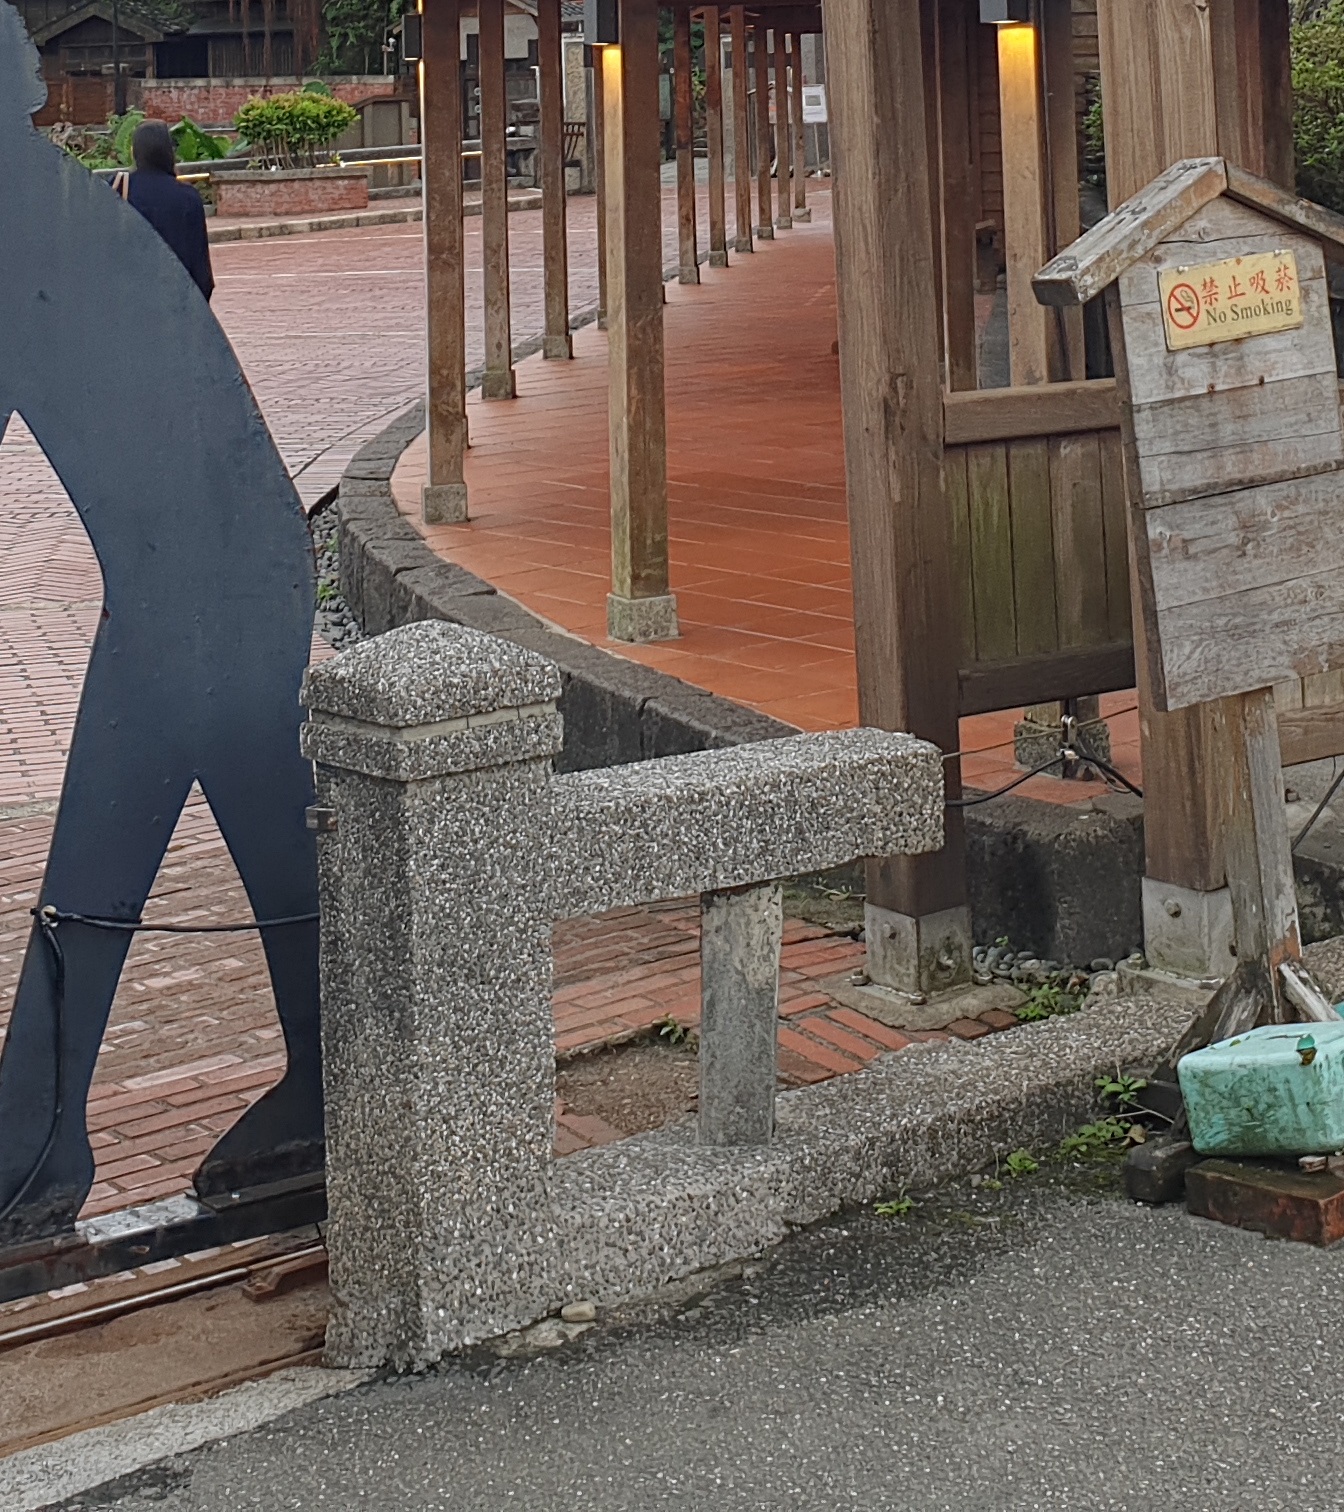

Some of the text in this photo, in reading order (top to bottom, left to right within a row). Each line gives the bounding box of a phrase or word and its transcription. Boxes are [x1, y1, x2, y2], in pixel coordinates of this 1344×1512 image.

[1201, 263, 1294, 307] 禁止吸菸
[1206, 297, 1294, 326] No Smoking
